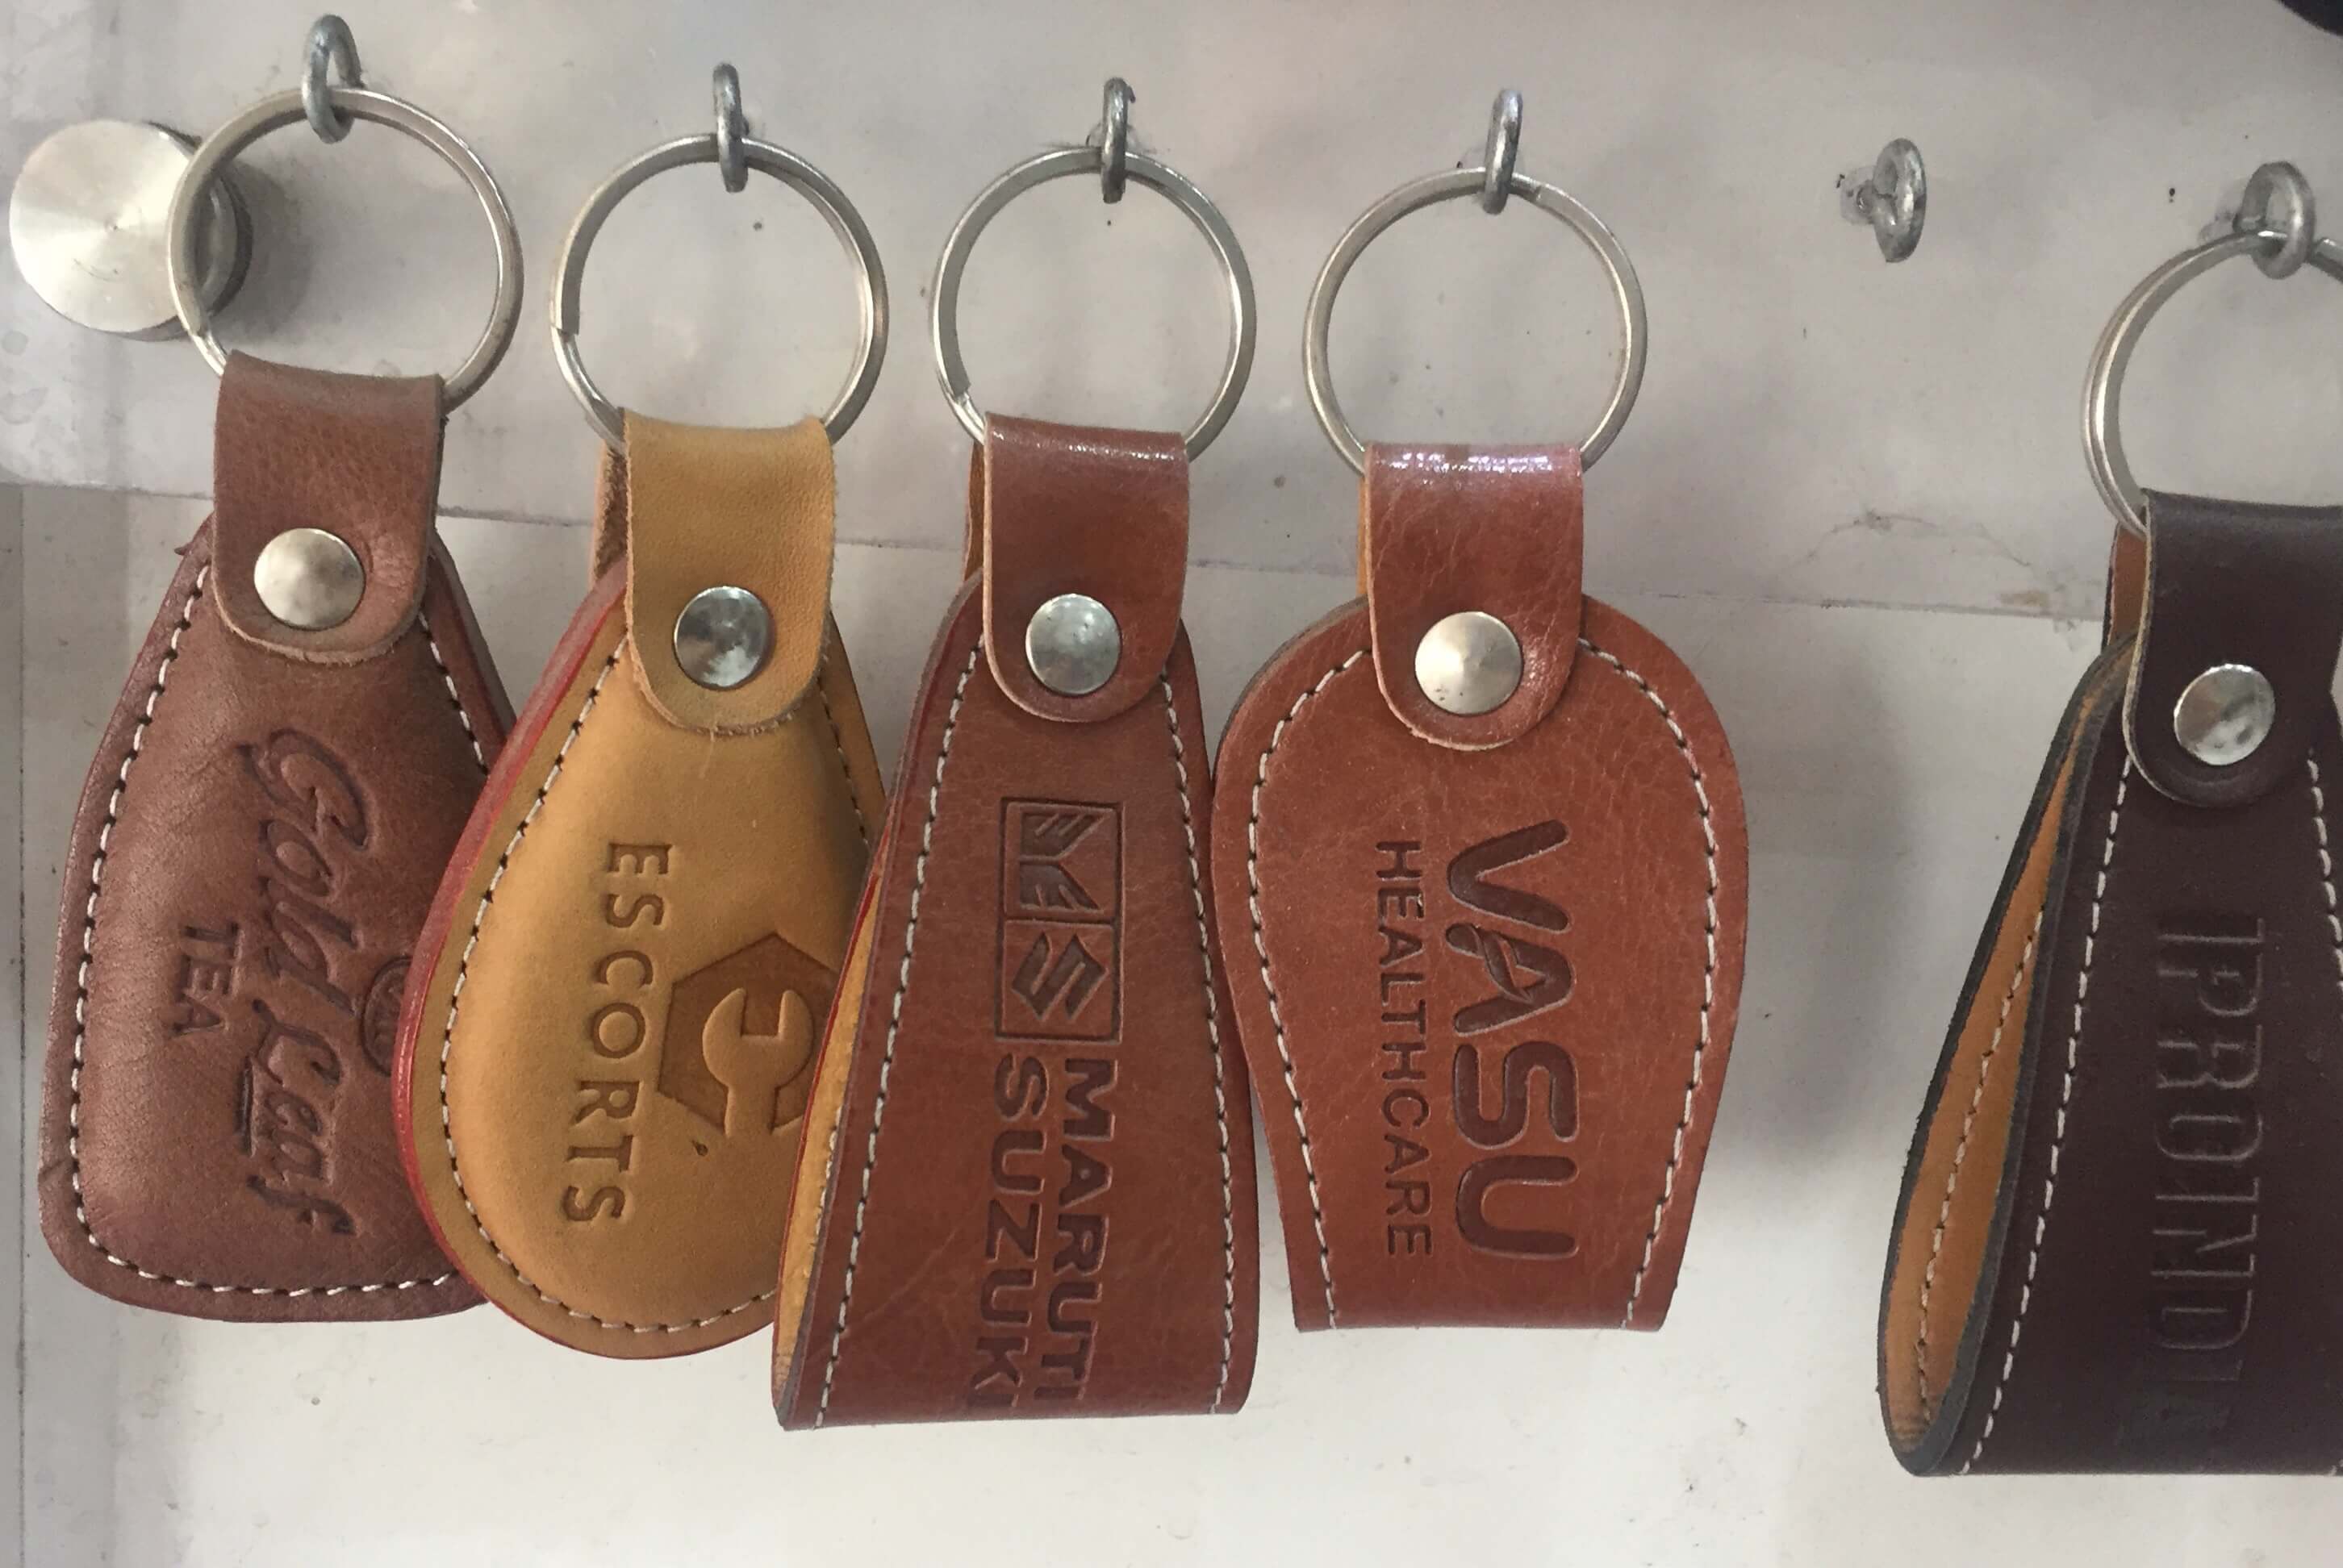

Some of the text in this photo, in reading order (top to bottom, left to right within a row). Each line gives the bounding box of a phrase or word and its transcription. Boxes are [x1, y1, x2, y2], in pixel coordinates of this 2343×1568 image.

[173, 922, 242, 1036] TEA
[238, 728, 368, 1236] Gold Leaf
[563, 843, 673, 1223] ESCORTS
[1376, 840, 1432, 1256] HEALTHCARE
[1446, 819, 1579, 1259] VASU
[970, 1052, 1049, 1408] SUZUKI
[1034, 1057, 1119, 1401] MARUTI
